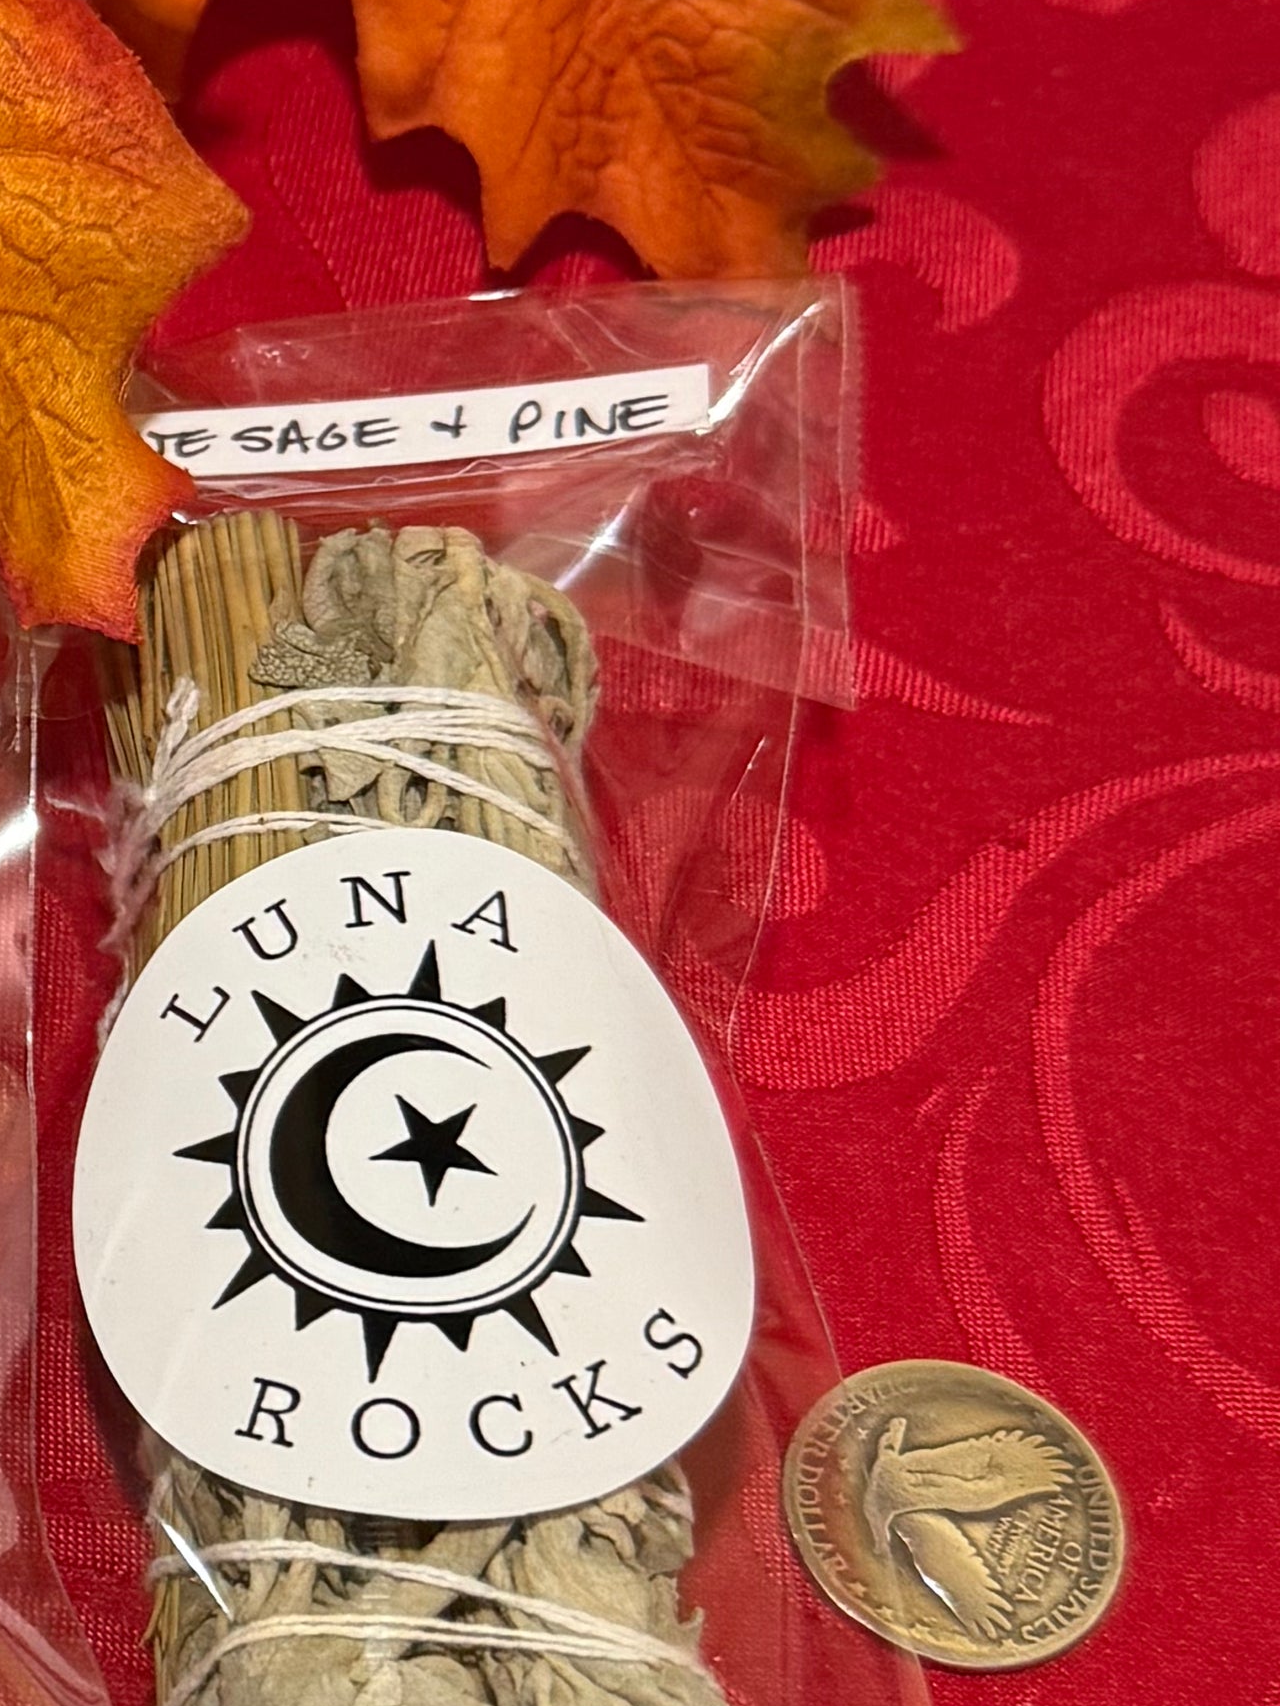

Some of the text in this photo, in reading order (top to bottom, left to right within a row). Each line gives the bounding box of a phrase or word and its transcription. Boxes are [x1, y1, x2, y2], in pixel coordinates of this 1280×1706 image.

[231, 418, 400, 458] SAGE
[508, 393, 670, 444] PINE
[160, 869, 519, 1043] LUNA
[234, 1307, 704, 1459] ROCKS
[1013, 1493, 1075, 1602] AMERICA
[1020, 1464, 1113, 1642] UNITED STATES
[1058, 1541, 1083, 1578] OF
